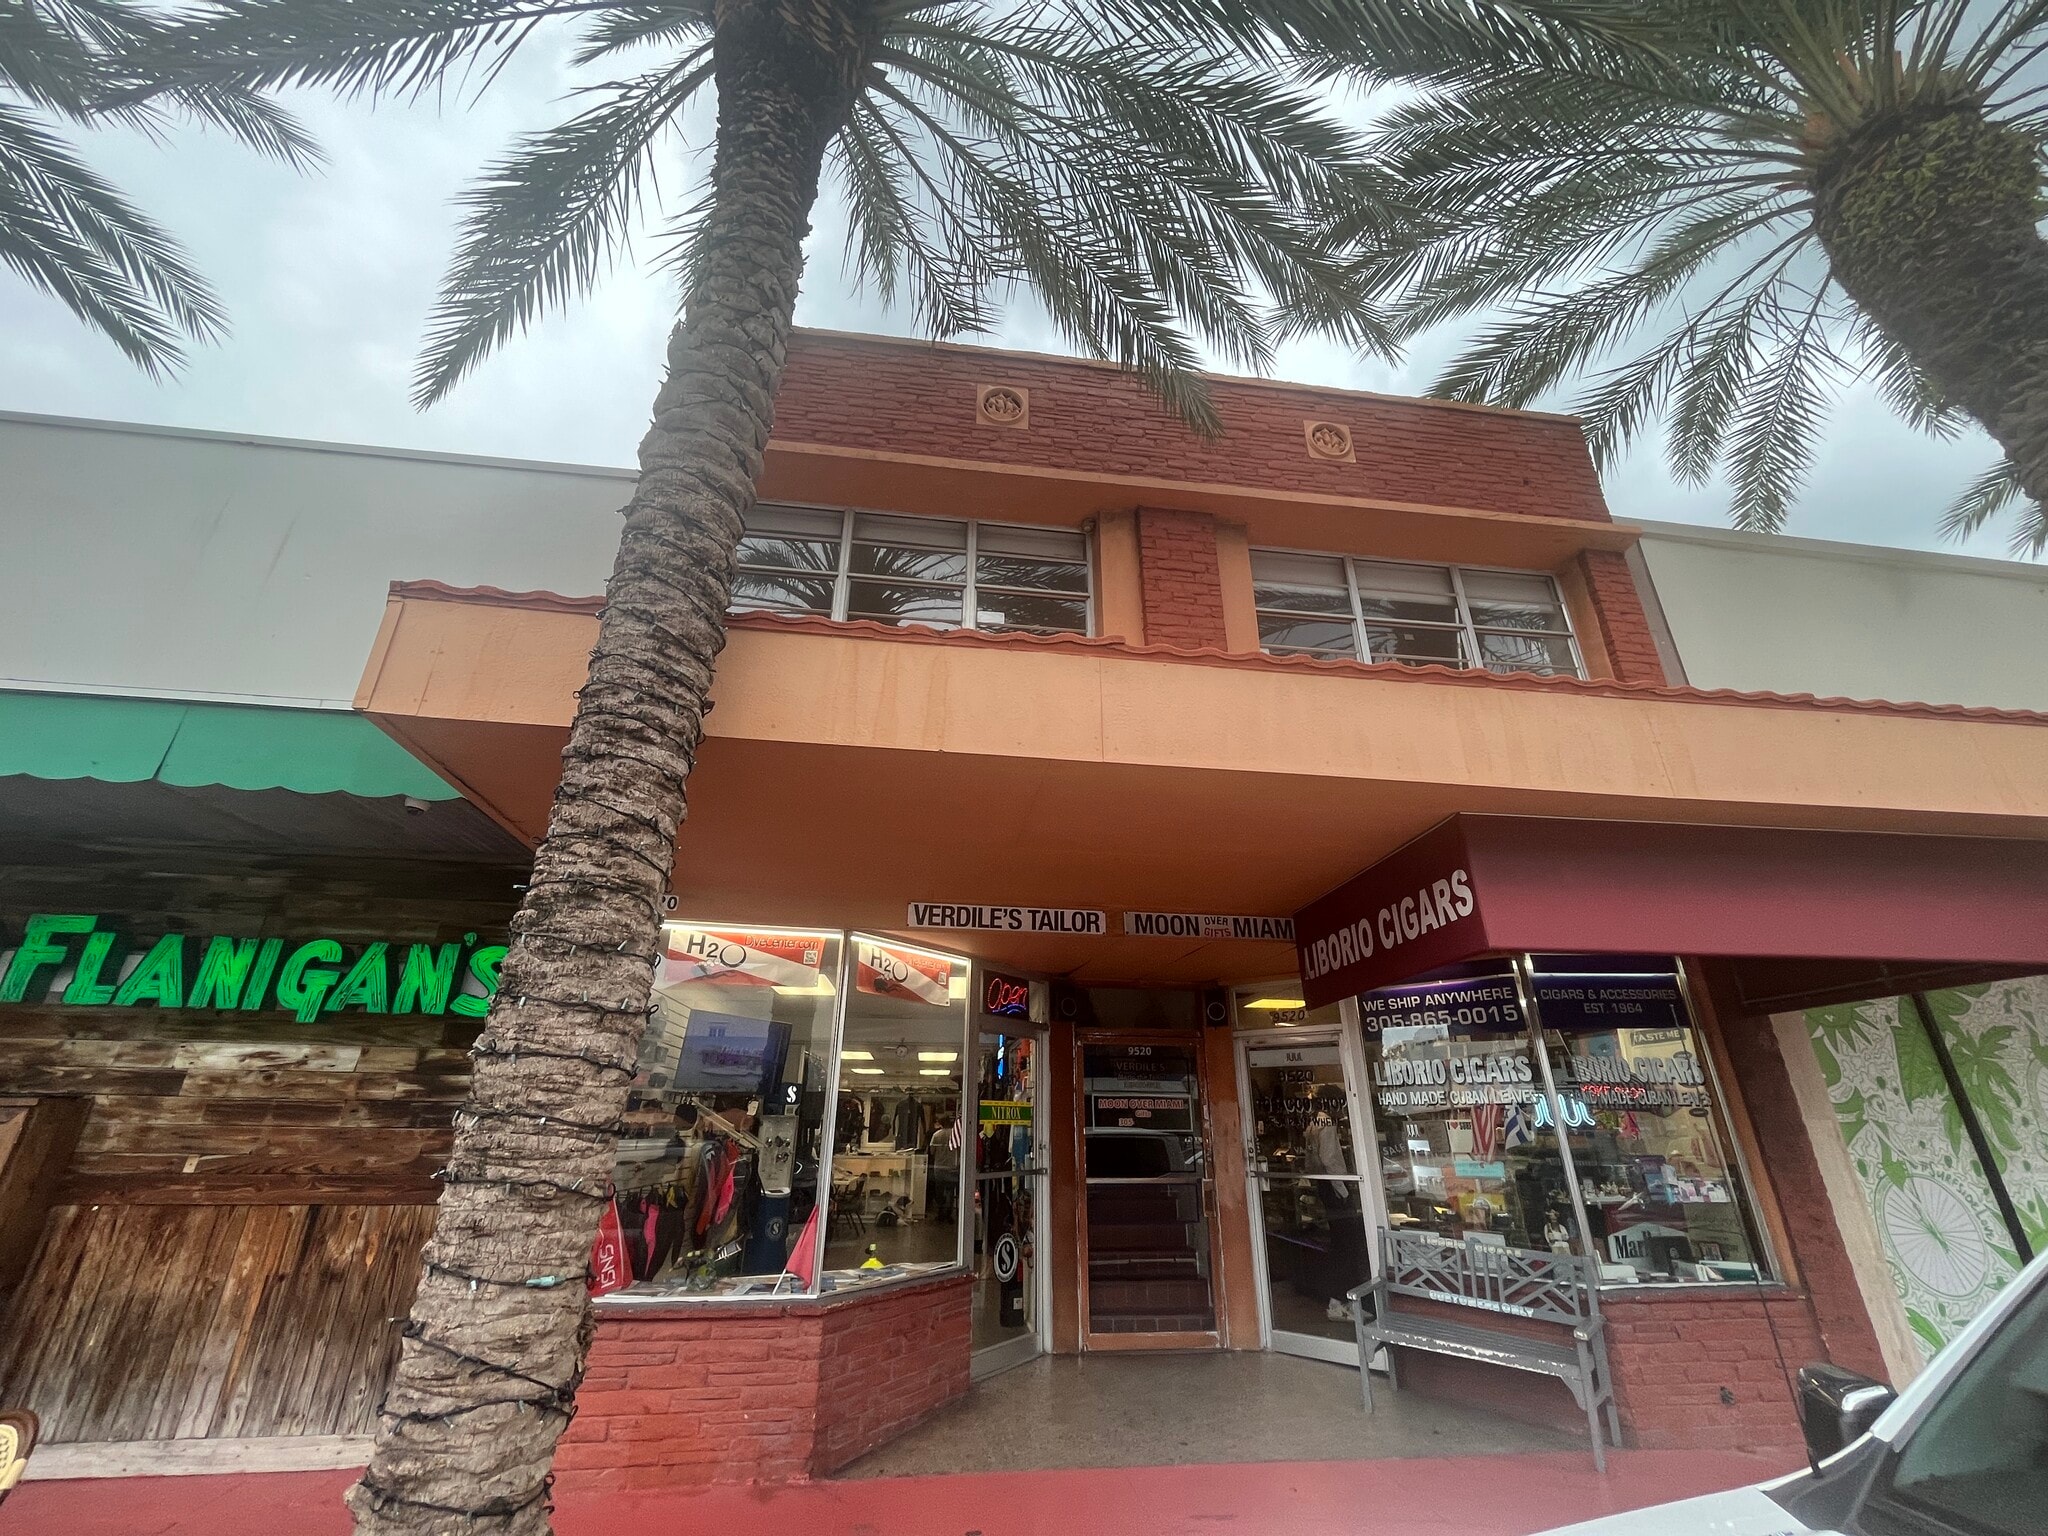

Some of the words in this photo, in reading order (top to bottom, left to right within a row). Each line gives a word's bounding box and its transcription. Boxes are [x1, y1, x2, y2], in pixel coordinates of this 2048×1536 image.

[914, 904, 1022, 930] VERDILE'S
[1028, 909, 1100, 933] TAILOR
[1134, 914, 1200, 936] MOON
[1204, 916, 1228, 926] OVER
[1304, 918, 1374, 981] LIBORIO
[1378, 869, 1474, 949] CIGARS
[1204, 928, 1231, 938] GIFTS
[687, 934, 747, 968] H2O
[0, 914, 509, 1023] FLANIGAN'S
[870, 948, 908, 984] H2O
[1363, 999, 1386, 1012] WE
[1388, 996, 1420, 1010] SHIP
[1425, 987, 1513, 1007] ANYWHERE
[1540, 989, 1584, 1000] CIGARS
[1588, 989, 1597, 1000] &
[1600, 989, 1676, 1000] ACCESSORIES
[1366, 1004, 1519, 1033] 305-865-0015
[1584, 1003, 1610, 1014] EST.
[1612, 1003, 1643, 1014] 1964
[1128, 1046, 1152, 1056] 9520
[1373, 1058, 1447, 1087] LIBORIO
[1450, 1055, 1533, 1085] CIGARS
[1378, 1091, 1408, 1106] HAND
[1410, 1090, 1447, 1105] MADE
[1450, 1090, 1489, 1105] CUBAN
[991, 1106, 1022, 1120] NITROX
